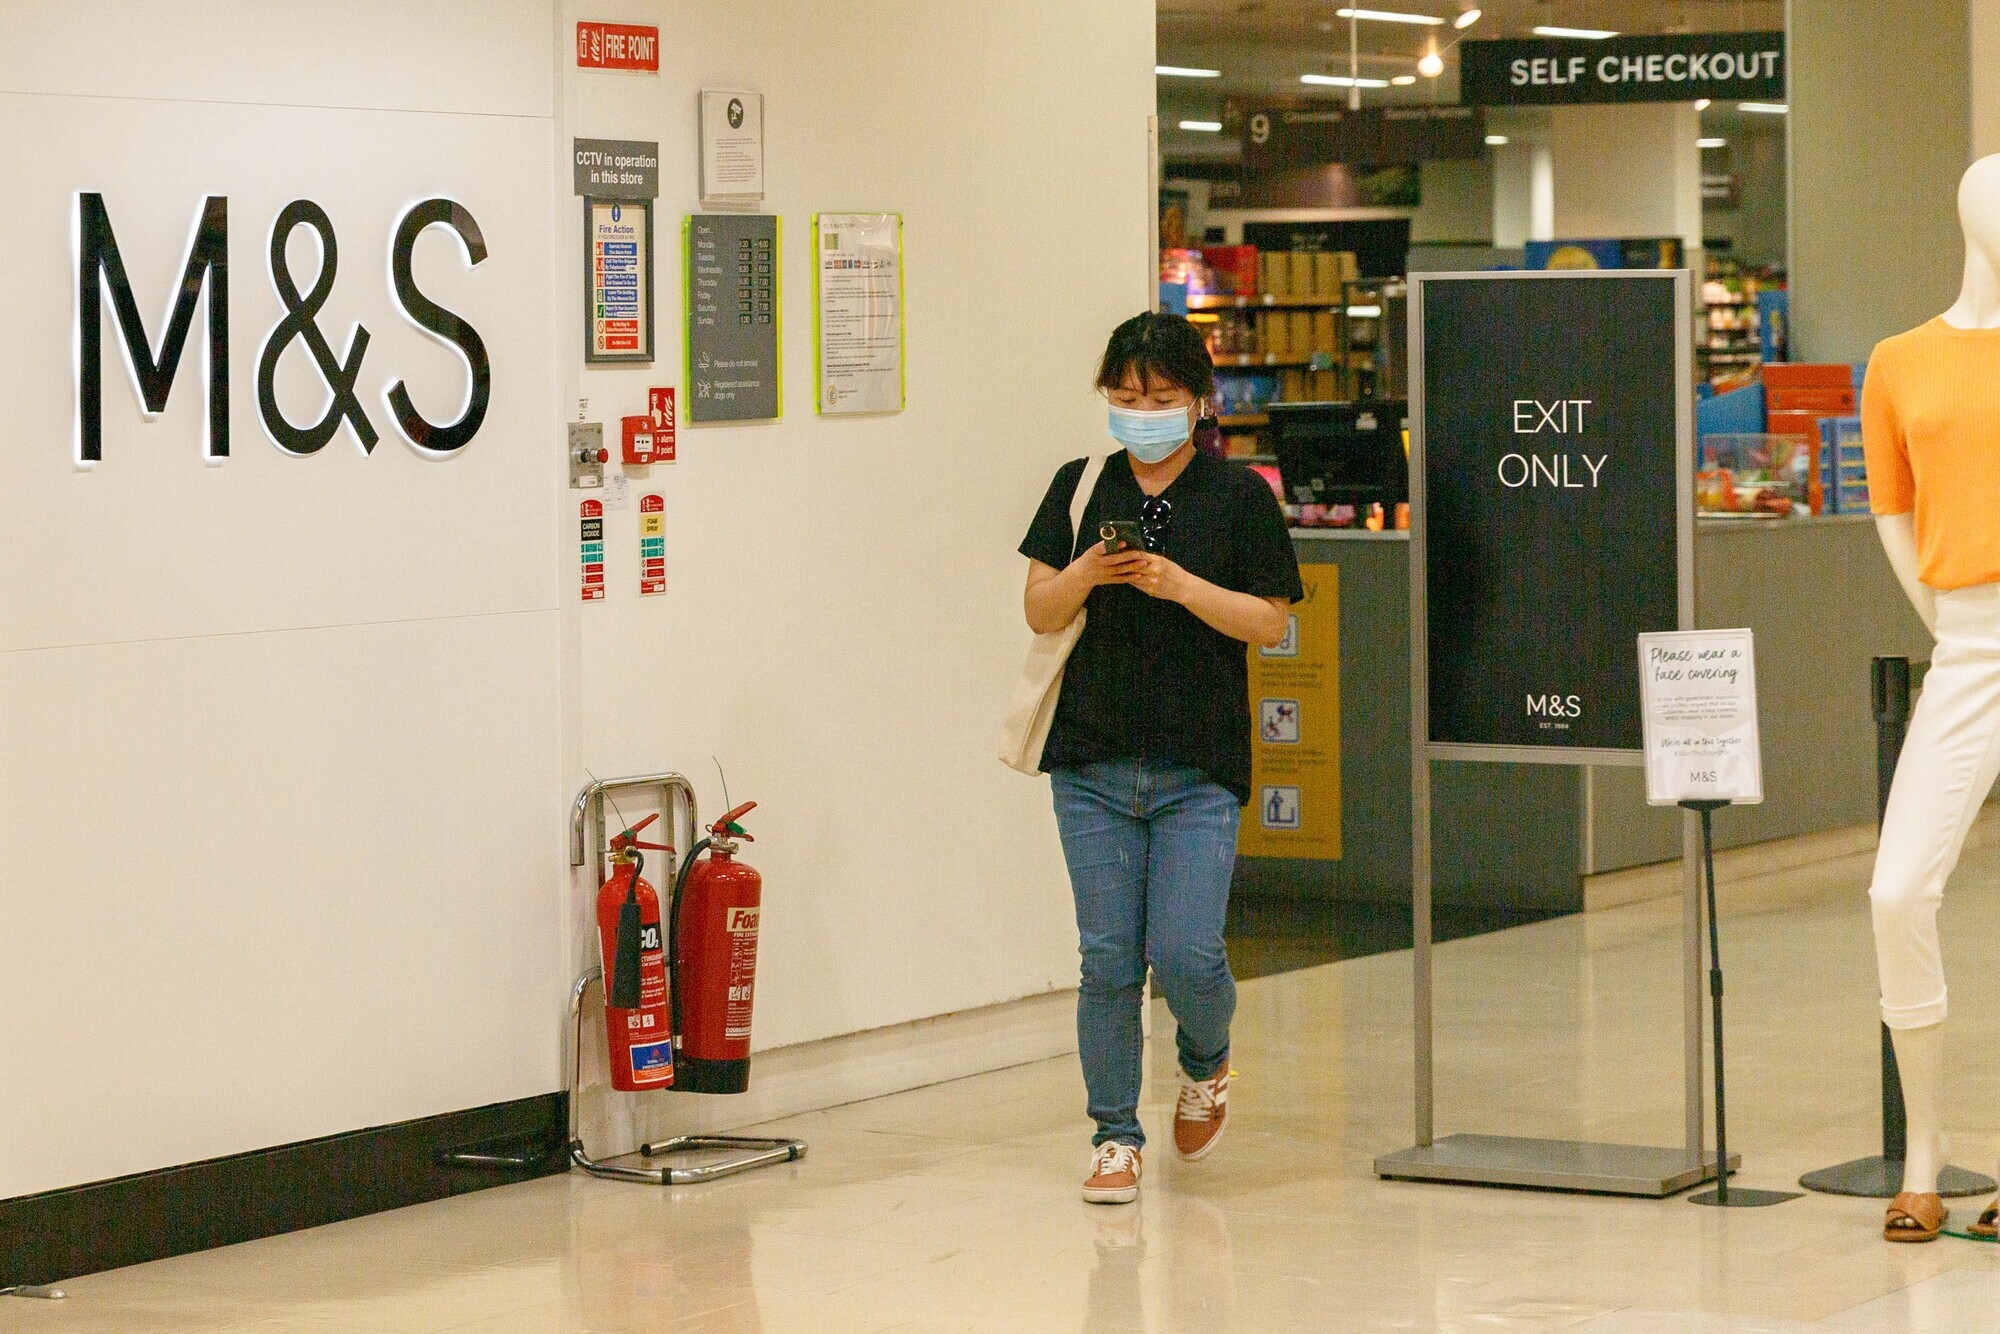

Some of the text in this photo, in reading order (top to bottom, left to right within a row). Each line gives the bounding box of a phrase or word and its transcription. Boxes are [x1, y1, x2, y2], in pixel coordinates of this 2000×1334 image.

[606, 34, 655, 60] FIRE POINT
[1510, 51, 1780, 86] SELF CHECKOUT
[1251, 114, 1270, 144] 9
[576, 151, 657, 170] CCTV in operation
[590, 170, 643, 185] in this store
[599, 224, 634, 233] Fire Action
[76, 191, 491, 462] M&S
[1513, 400, 1592, 433] EXIT
[660, 435, 674, 443] alarm
[660, 445, 674, 456] point
[1498, 453, 1608, 488] ONLY
[582, 522, 600, 530] CARBON
[582, 529, 600, 538] DIOXIDE
[1650, 647, 1743, 666] Please wear a
[1655, 666, 1740, 685] face covering
[1527, 693, 1581, 718] M&S
[1689, 771, 1718, 783] M&S
[731, 910, 759, 929] Foa
